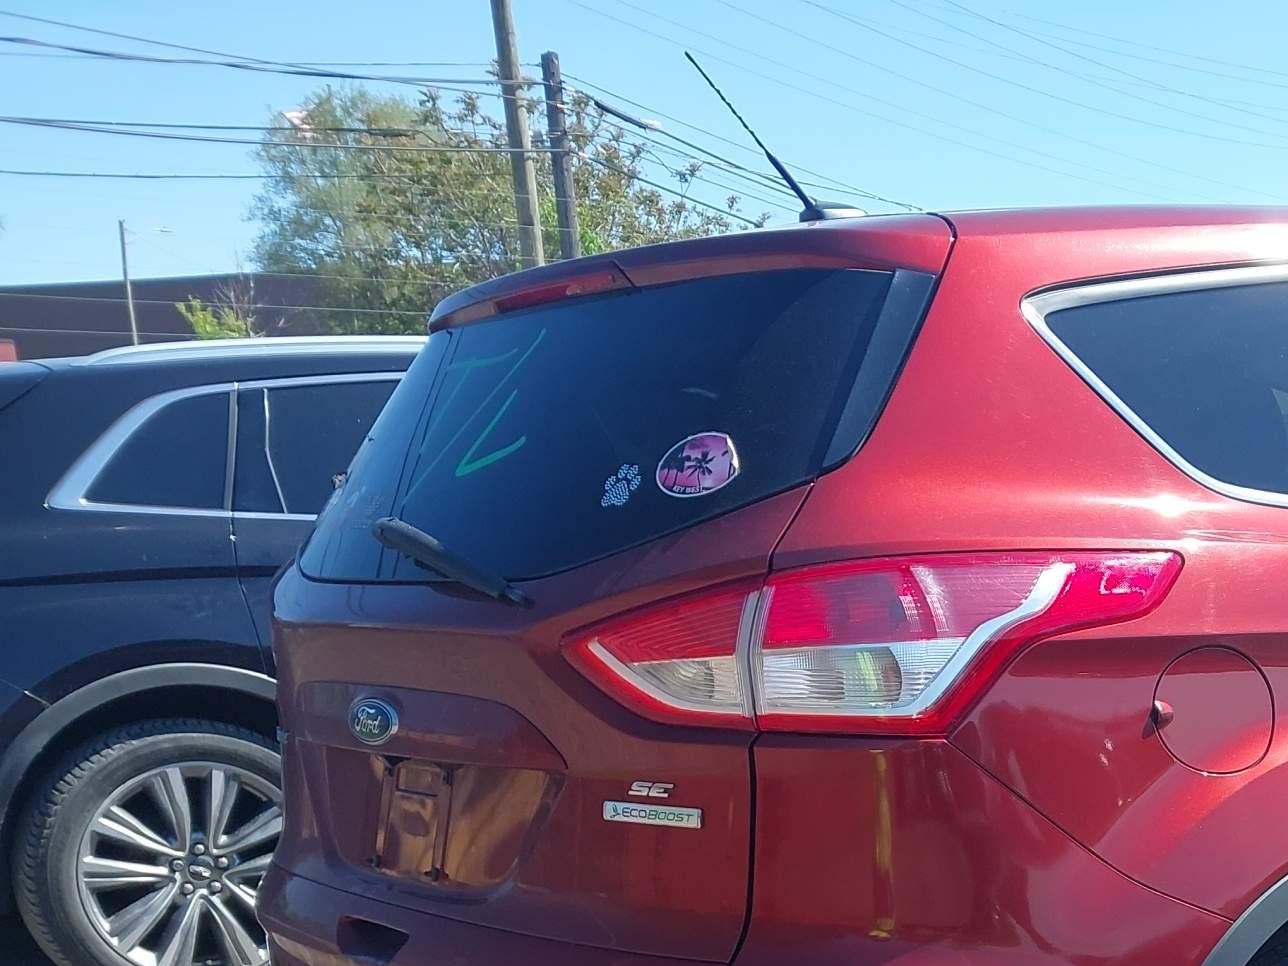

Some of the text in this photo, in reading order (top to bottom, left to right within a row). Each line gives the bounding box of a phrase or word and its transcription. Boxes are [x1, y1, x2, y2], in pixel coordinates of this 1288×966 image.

[354, 706, 382, 734] Ford
[628, 781, 674, 798] SE
[621, 807, 695, 823] ECOBOOST
